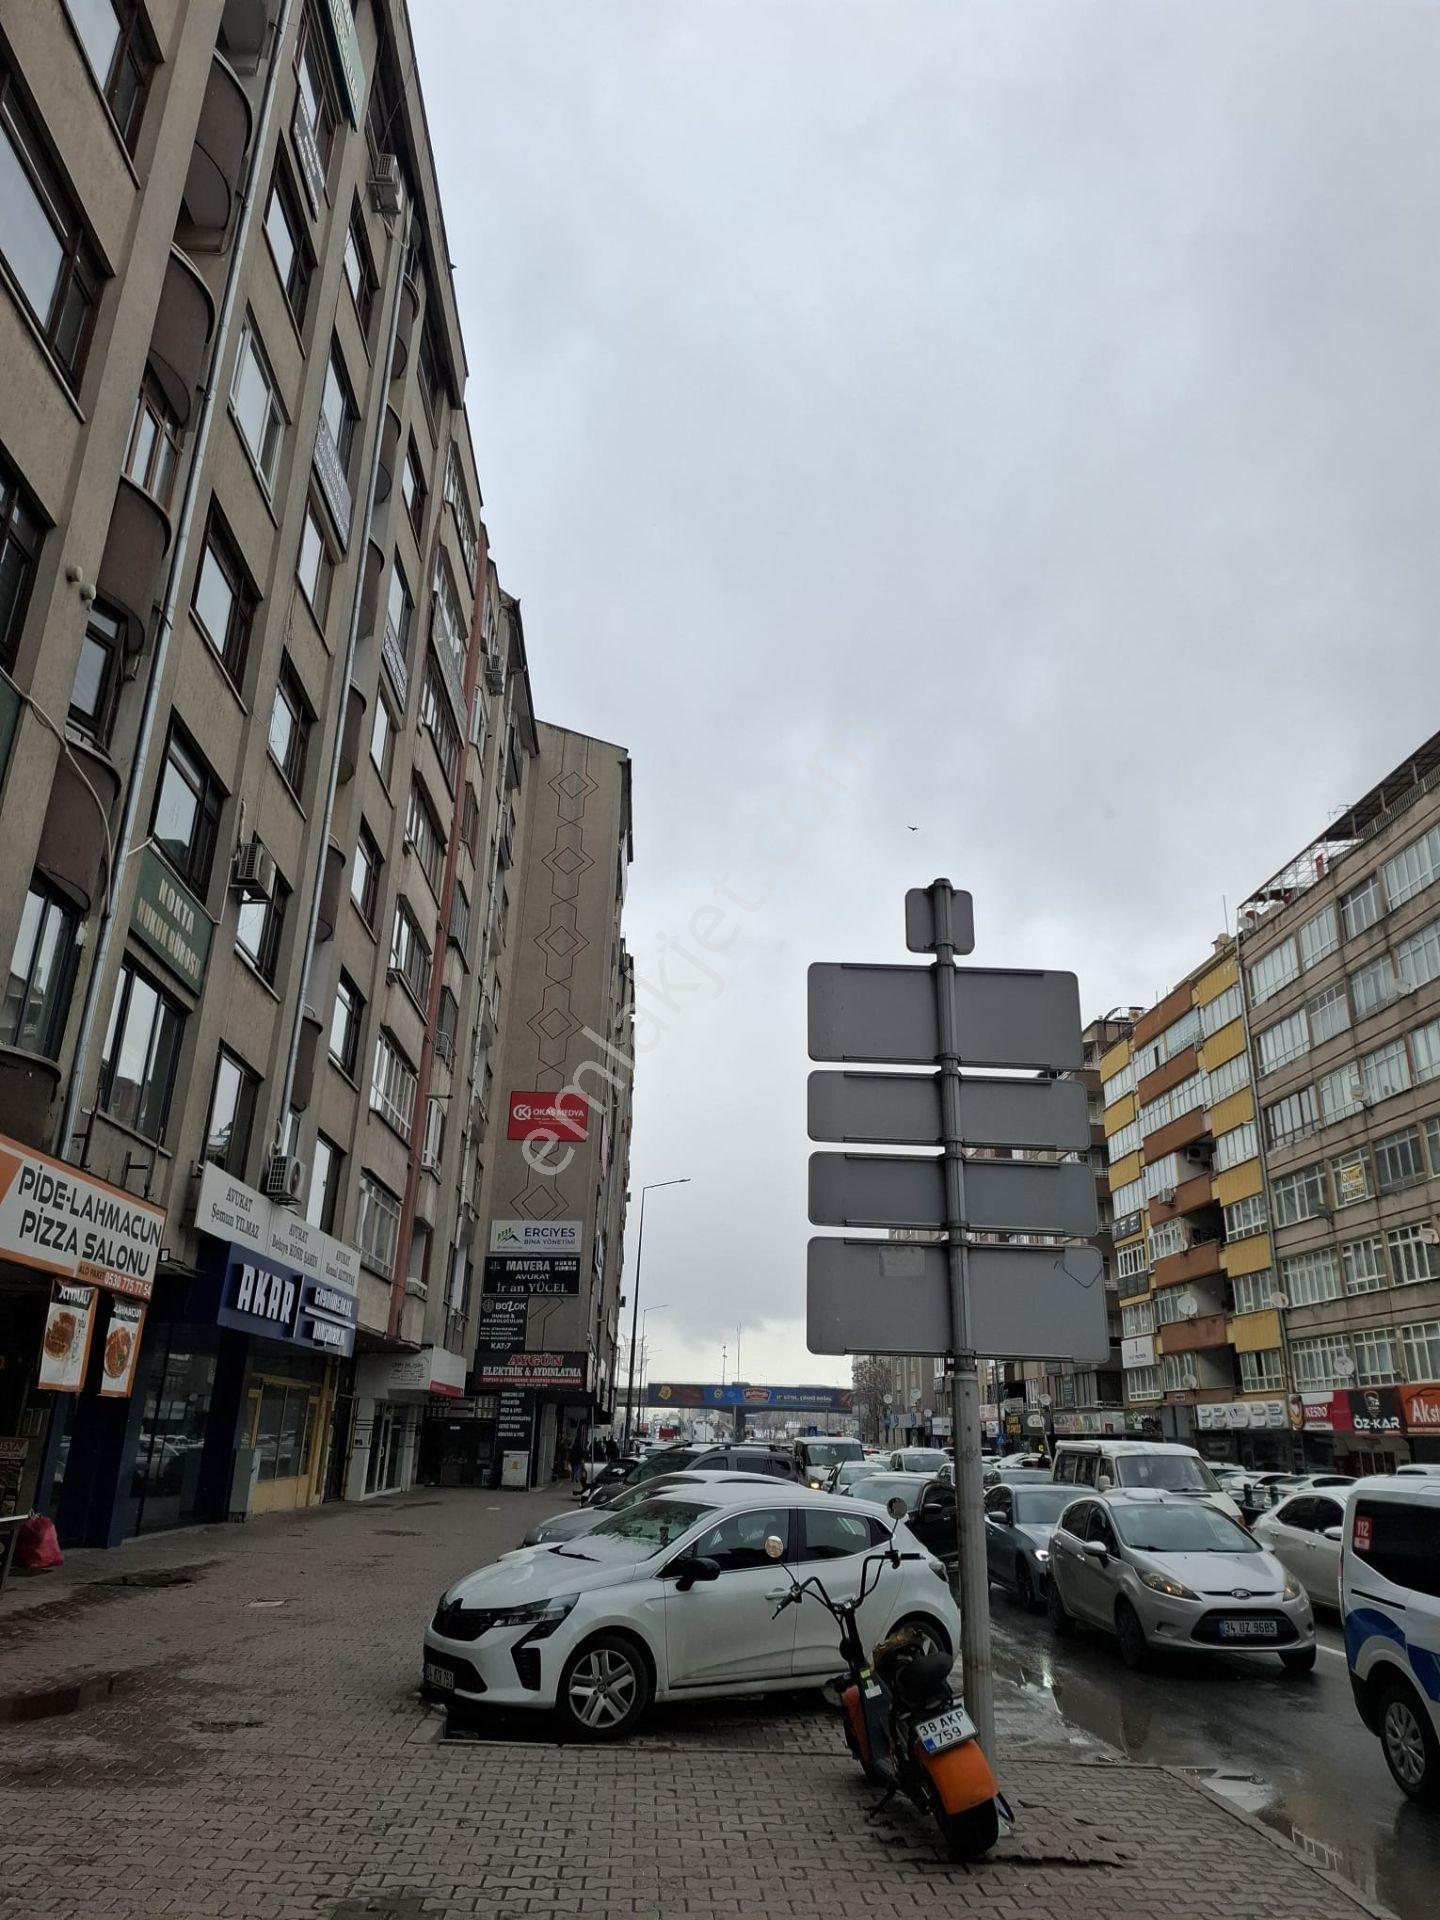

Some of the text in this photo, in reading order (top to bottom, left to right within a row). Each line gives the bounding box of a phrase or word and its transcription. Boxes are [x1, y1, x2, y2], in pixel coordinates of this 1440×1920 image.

[159, 878, 194, 935] NOKTA
[137, 897, 200, 980] HUKUK BÜROSU
[556, 1108, 584, 1117] MEDYA
[18, 1164, 162, 1248] PİDE-LAHMACUN
[226, 1186, 253, 1213] AVUKAT
[235, 1214, 260, 1239] YILMAZ
[289, 1224, 309, 1244] AVUKAT
[19, 1207, 151, 1277] PİZZA SALONU
[506, 1260, 551, 1271] MAVERA
[105, 1272, 121, 1288] 0530
[122, 1276, 134, 1292] 775
[134, 1280, 143, 1294] 77
[528, 1281, 568, 1293] YÜCEL
[237, 1263, 295, 1324] AKAR
[495, 1301, 526, 1311] BOZOK
[508, 1353, 564, 1366] AYGÜN
[482, 1365, 582, 1377] ELEKTRİK & AYDINLATMA
[1353, 1414, 1400, 1429] ÖZ-KAR
[1357, 1521, 1369, 1537] 112
[1225, 1622, 1235, 1633] 34
[1239, 1622, 1250, 1633] UZ
[920, 1710, 963, 1737] 38 AKP
[934, 1726, 962, 1744] 759
